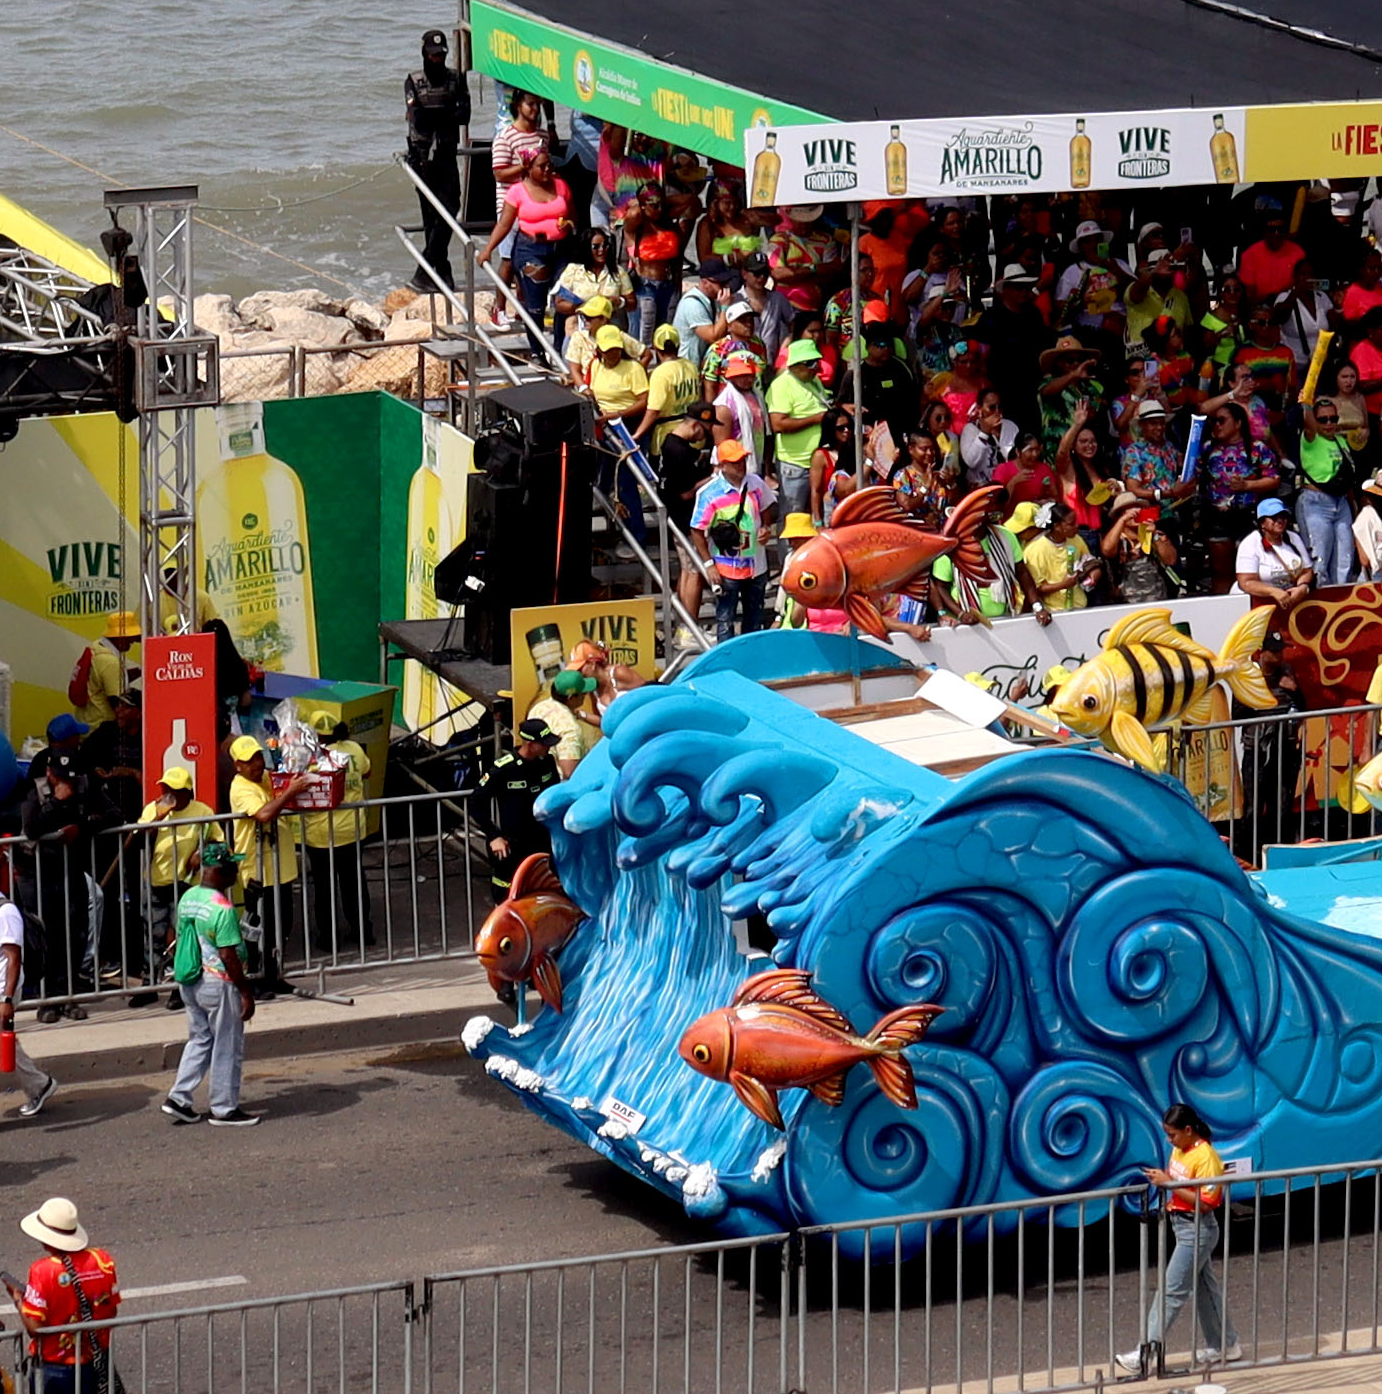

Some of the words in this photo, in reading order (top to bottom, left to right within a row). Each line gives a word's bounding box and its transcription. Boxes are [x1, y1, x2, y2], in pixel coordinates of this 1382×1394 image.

[946, 121, 1034, 152] Aguardiente
[1118, 127, 1171, 154] VIVE
[1332, 132, 1342, 151] LA
[803, 139, 857, 167] VIVE
[939, 145, 1042, 185] AMARILLO
[1120, 158, 1169, 178] FRONTERAS
[806, 172, 857, 192] FRONTERAS
[956, 179, 968, 188] DE
[208, 519, 294, 557] Aguardiente
[46, 541, 122, 583] VIVE
[205, 542, 305, 593] AMARILLO
[50, 590, 120, 615] FRONTERAS
[581, 615, 637, 643] VIVE
[155, 667, 204, 681] CALDAS
